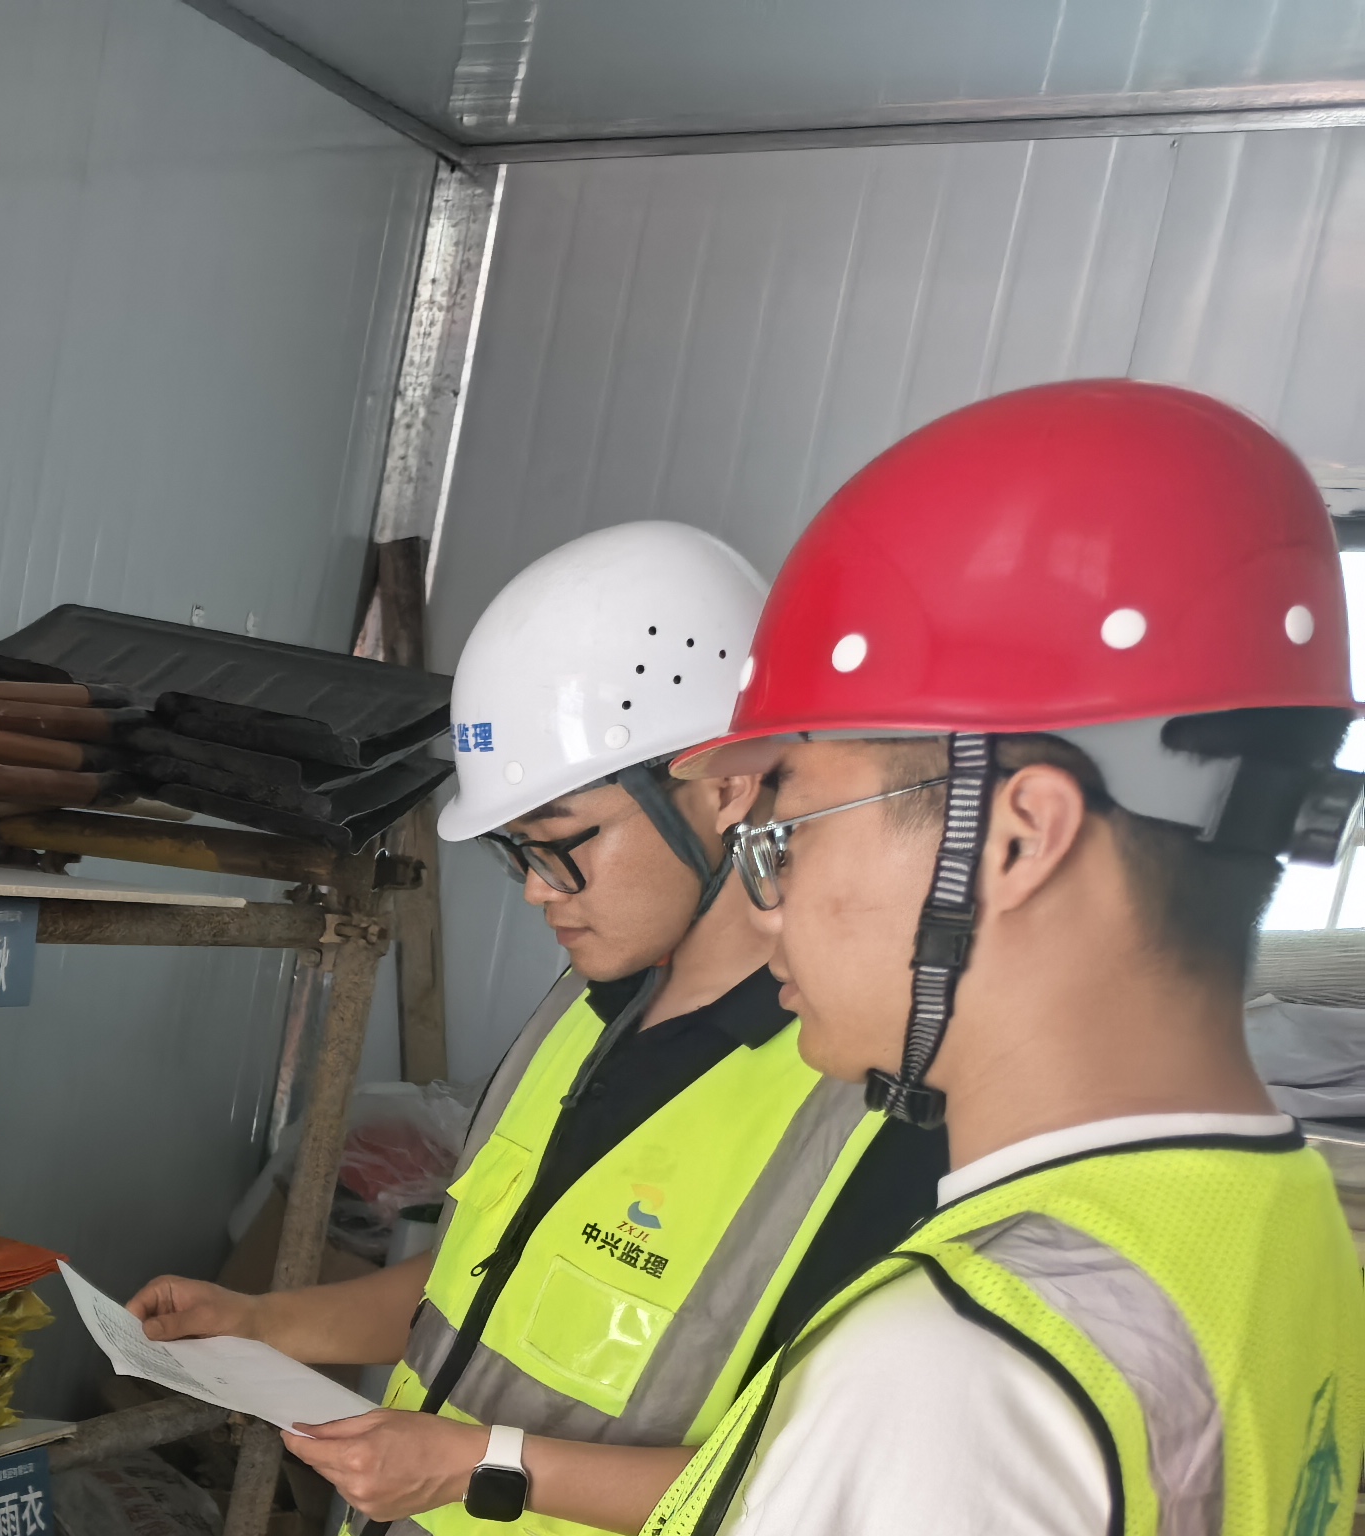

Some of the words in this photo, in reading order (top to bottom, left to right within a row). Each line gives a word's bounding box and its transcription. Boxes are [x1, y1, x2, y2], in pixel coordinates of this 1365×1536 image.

[450, 722, 494, 752] 监理
[616, 1221, 651, 1243] ZXJL
[581, 1222, 669, 1279] 中兴监理
